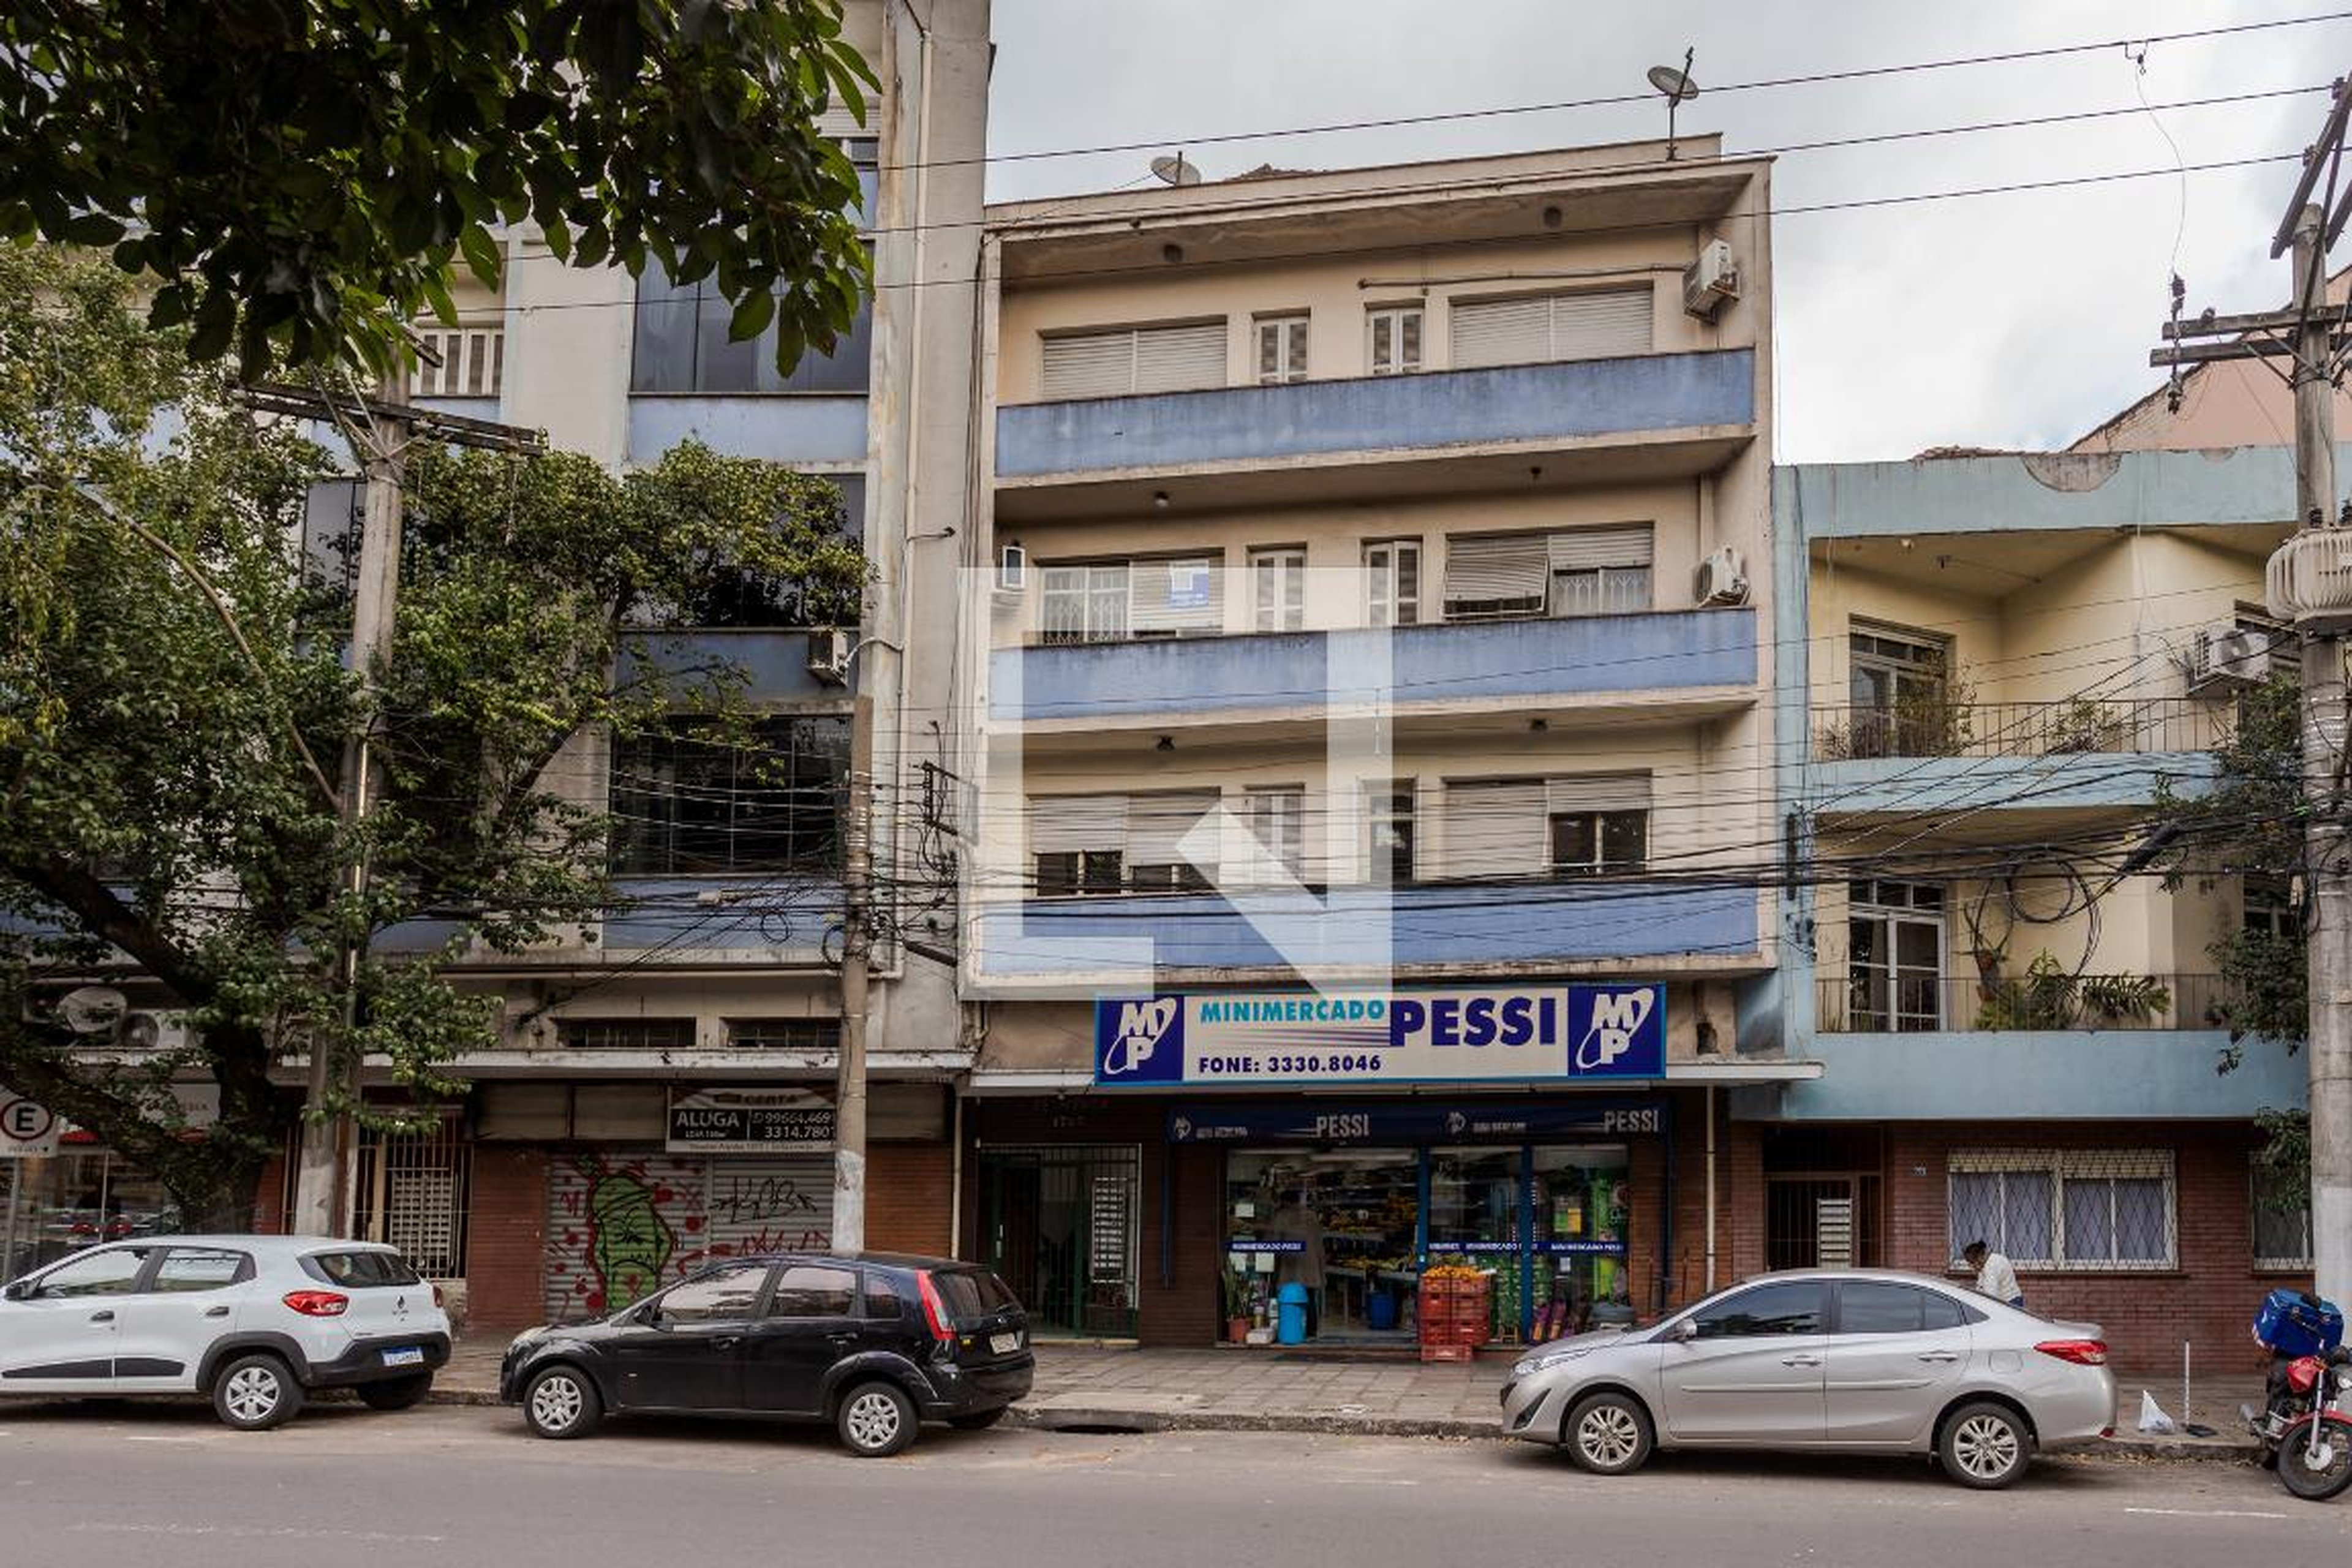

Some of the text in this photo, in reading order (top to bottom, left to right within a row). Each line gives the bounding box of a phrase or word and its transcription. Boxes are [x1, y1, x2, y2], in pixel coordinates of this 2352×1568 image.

[1200, 997, 1556, 1046] MINIMERCADO PESSI
[1199, 1055, 1381, 1072] FONE: 3330.8046
[16, 1107, 36, 1131] E
[676, 1111, 739, 1127] ALUGA
[1317, 1114, 1369, 1137] PESSI
[1604, 1110, 1658, 1133] PESSI
[765, 1126, 834, 1138] 3314.780
